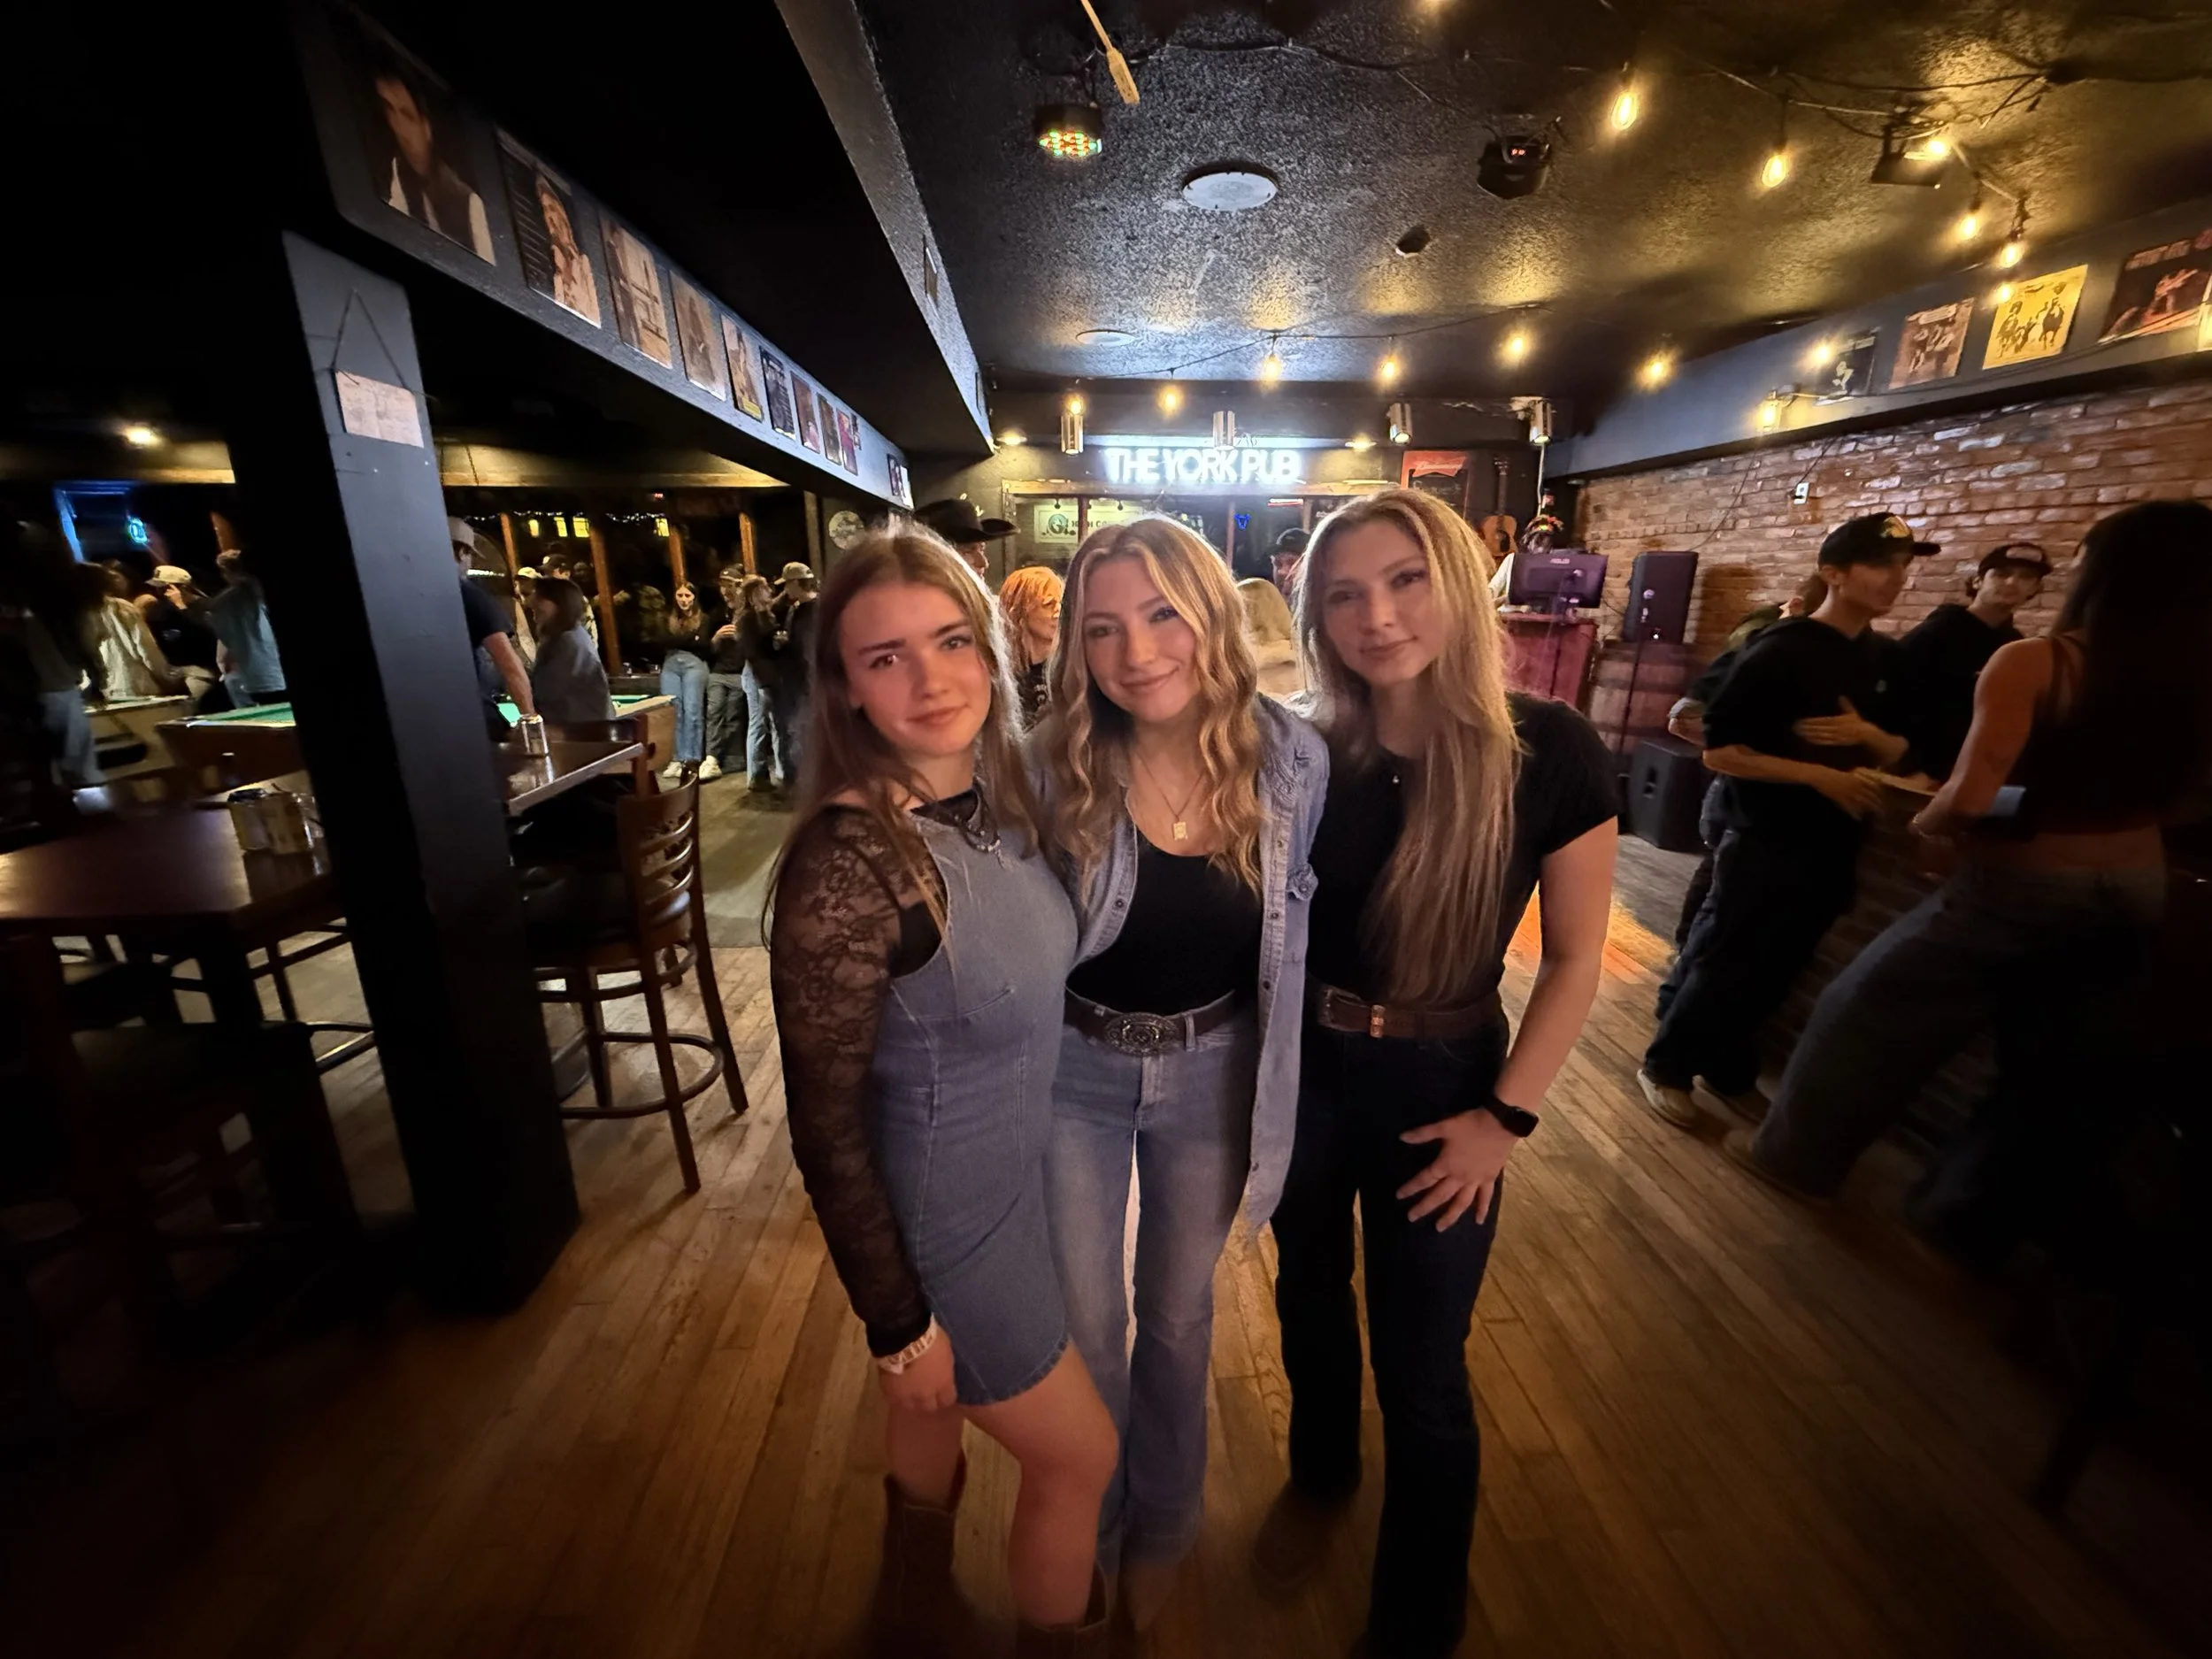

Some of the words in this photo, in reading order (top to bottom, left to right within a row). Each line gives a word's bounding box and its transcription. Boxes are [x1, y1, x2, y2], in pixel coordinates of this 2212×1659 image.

[1105, 448, 1161, 484] THE
[1164, 448, 1238, 484] YORK
[1240, 449, 1302, 485] PUB
